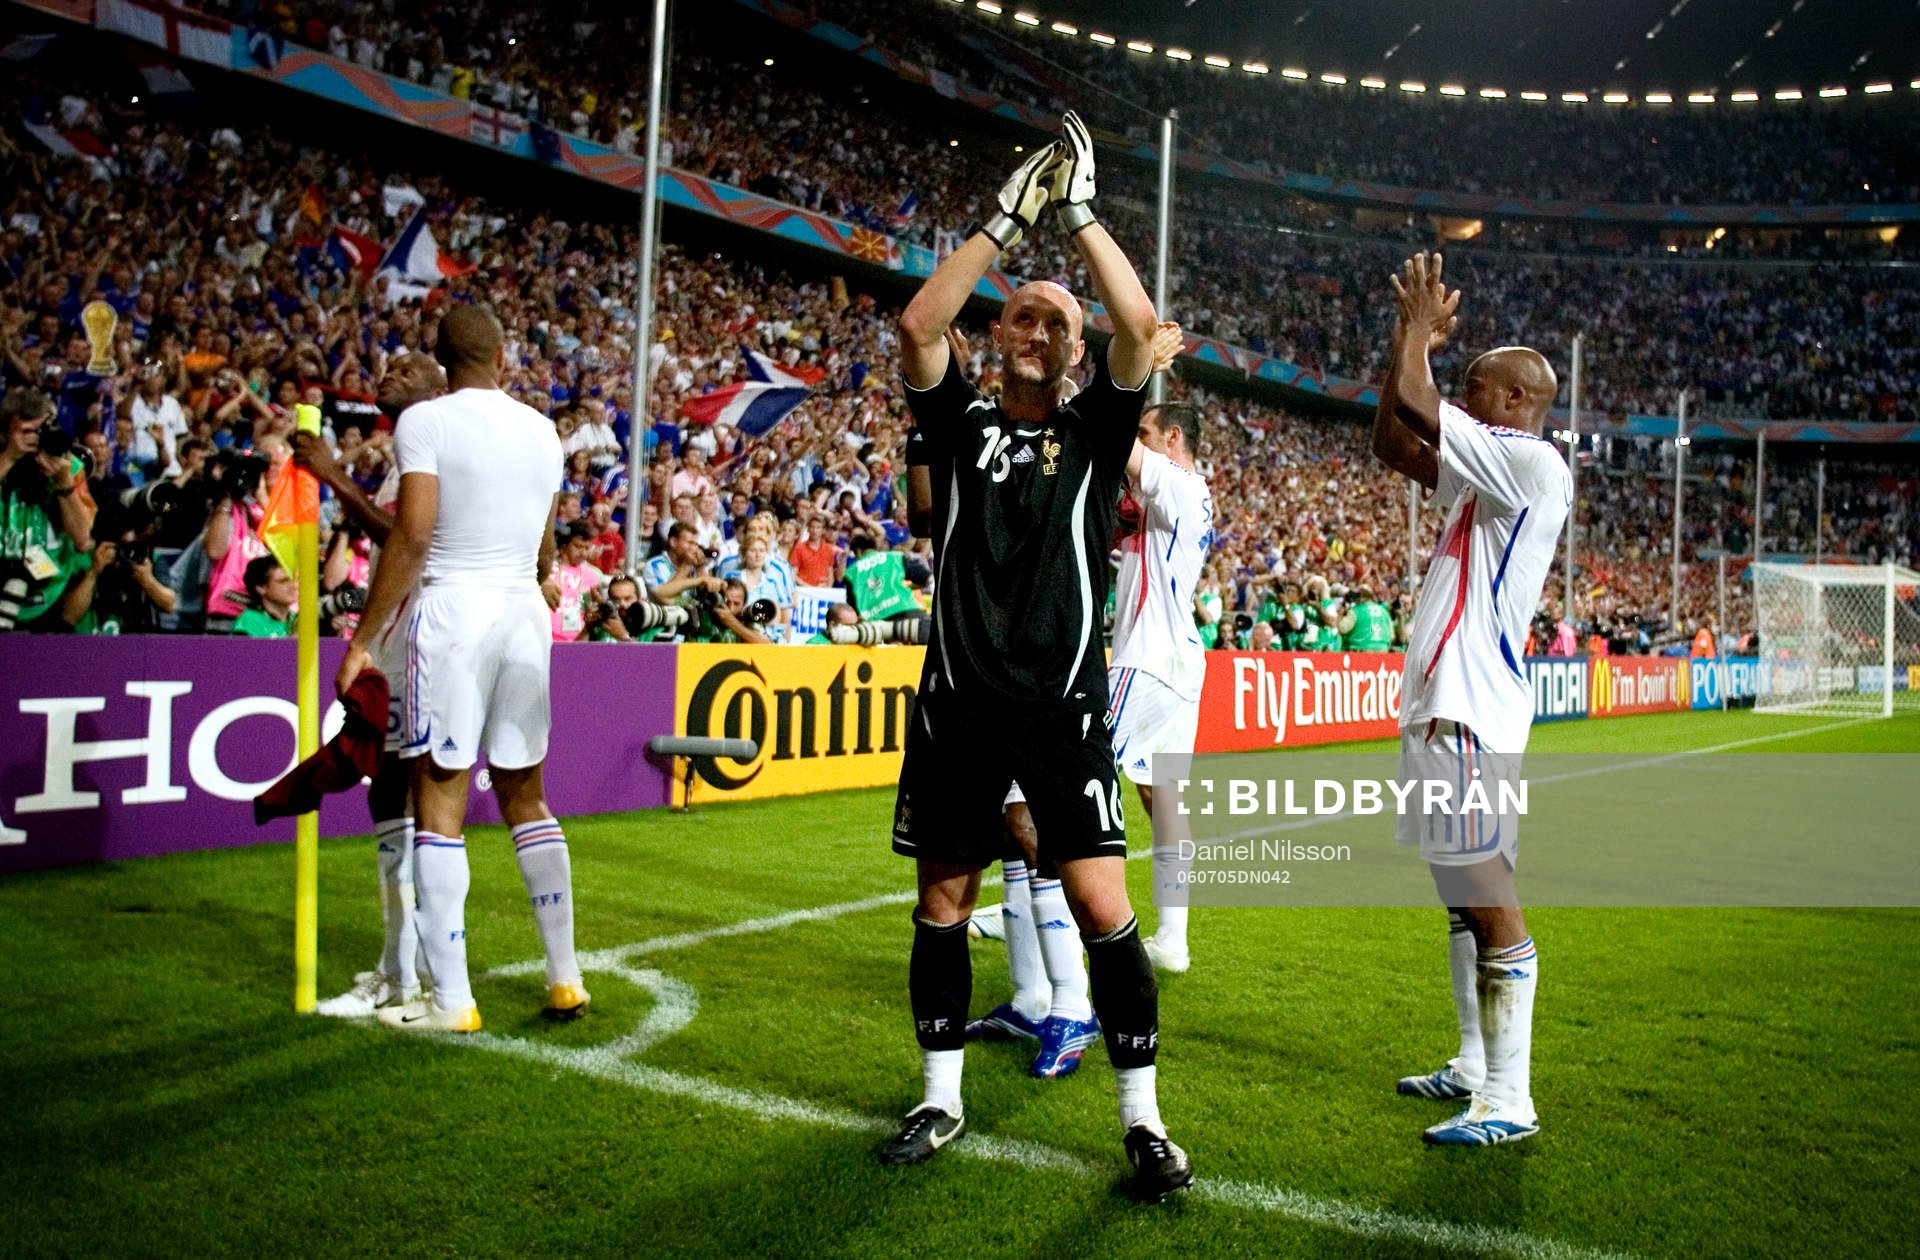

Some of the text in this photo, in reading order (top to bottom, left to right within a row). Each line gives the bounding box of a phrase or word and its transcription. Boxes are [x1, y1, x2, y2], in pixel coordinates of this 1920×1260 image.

[791, 600, 832, 634] ALLE
[1233, 654, 1403, 743] Fly Emirate
